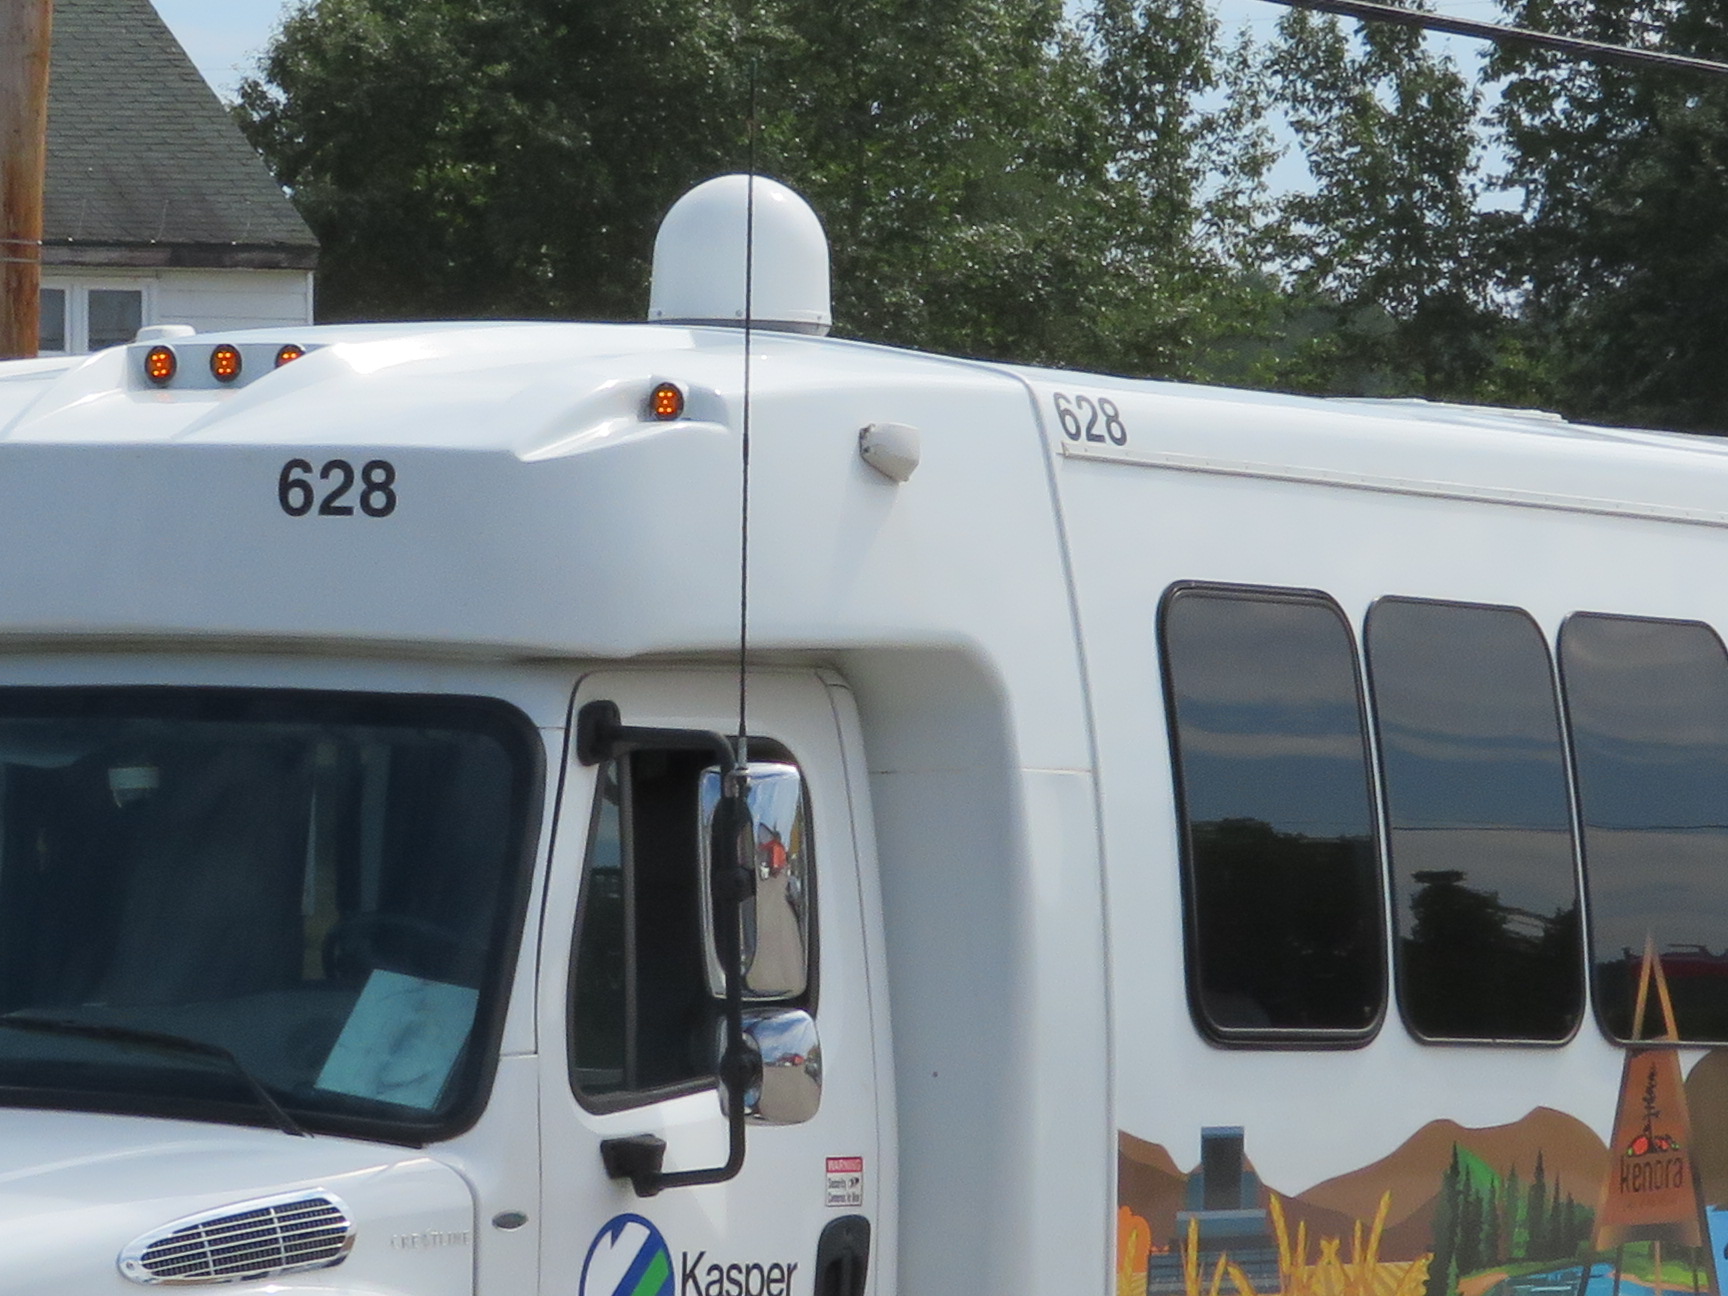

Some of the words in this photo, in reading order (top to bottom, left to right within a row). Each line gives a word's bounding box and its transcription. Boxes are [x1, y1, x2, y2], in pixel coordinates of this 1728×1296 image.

[1052, 391, 1128, 447] 628
[277, 458, 398, 518] 628
[1619, 1155, 1684, 1194] kenora
[389, 1229, 472, 1250] CRESTLINE
